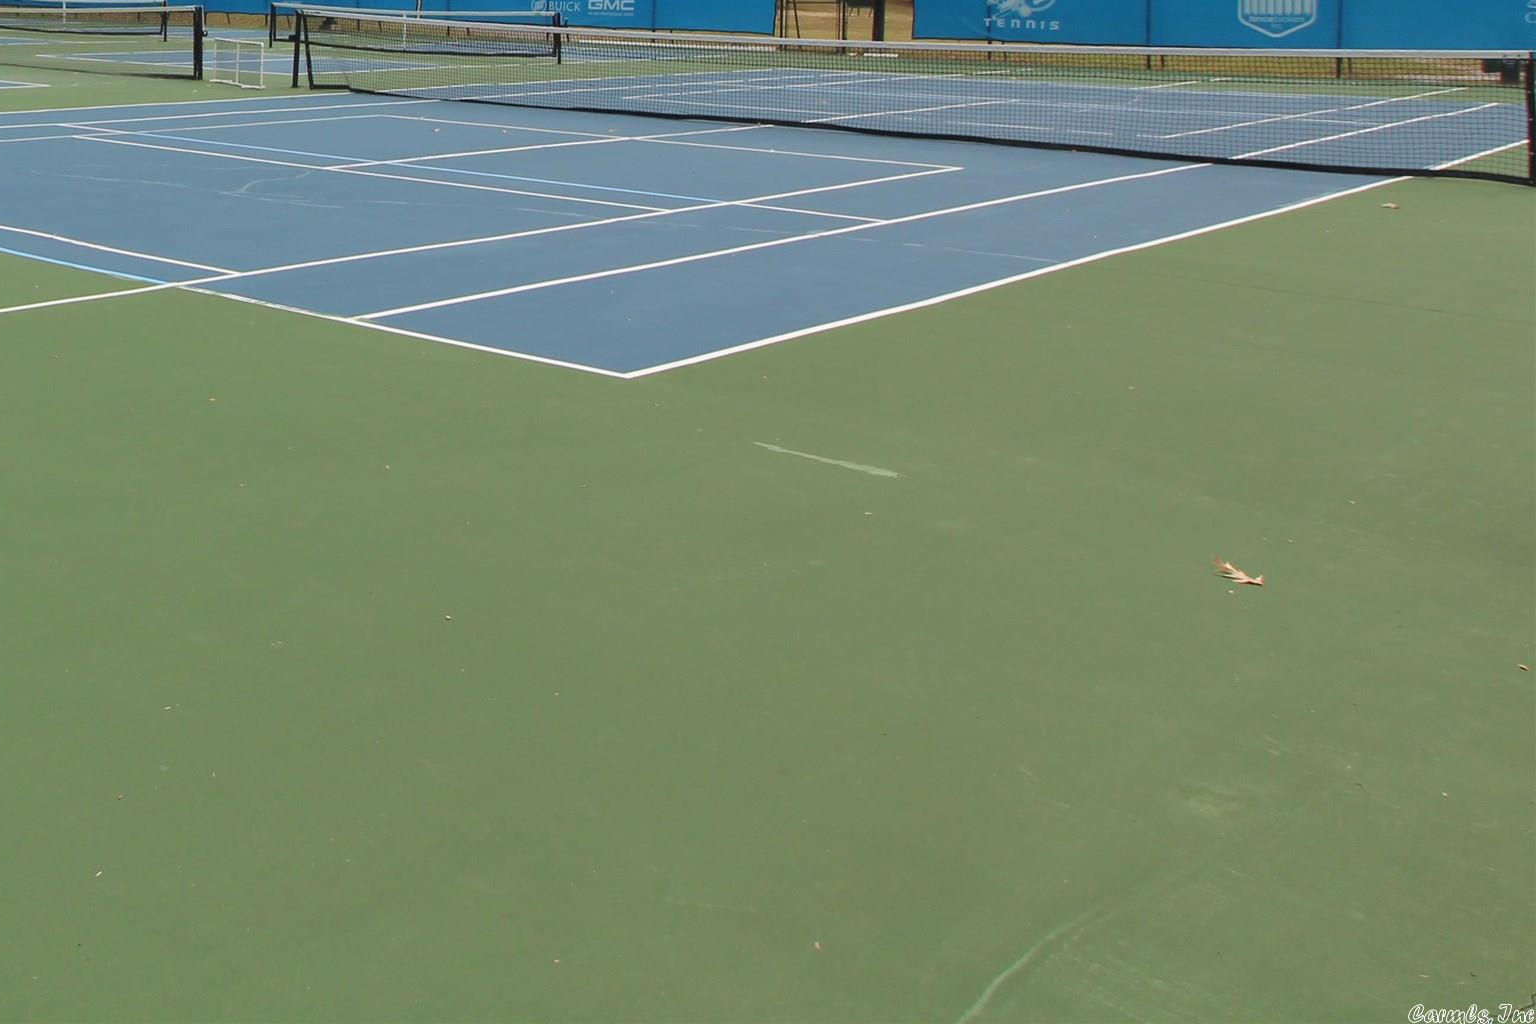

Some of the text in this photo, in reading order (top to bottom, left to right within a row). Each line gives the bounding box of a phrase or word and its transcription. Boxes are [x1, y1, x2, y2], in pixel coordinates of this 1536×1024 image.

[549, 1, 581, 11] BUICK
[588, 0, 635, 11] GMC
[984, 18, 1060, 31] TENNIS
